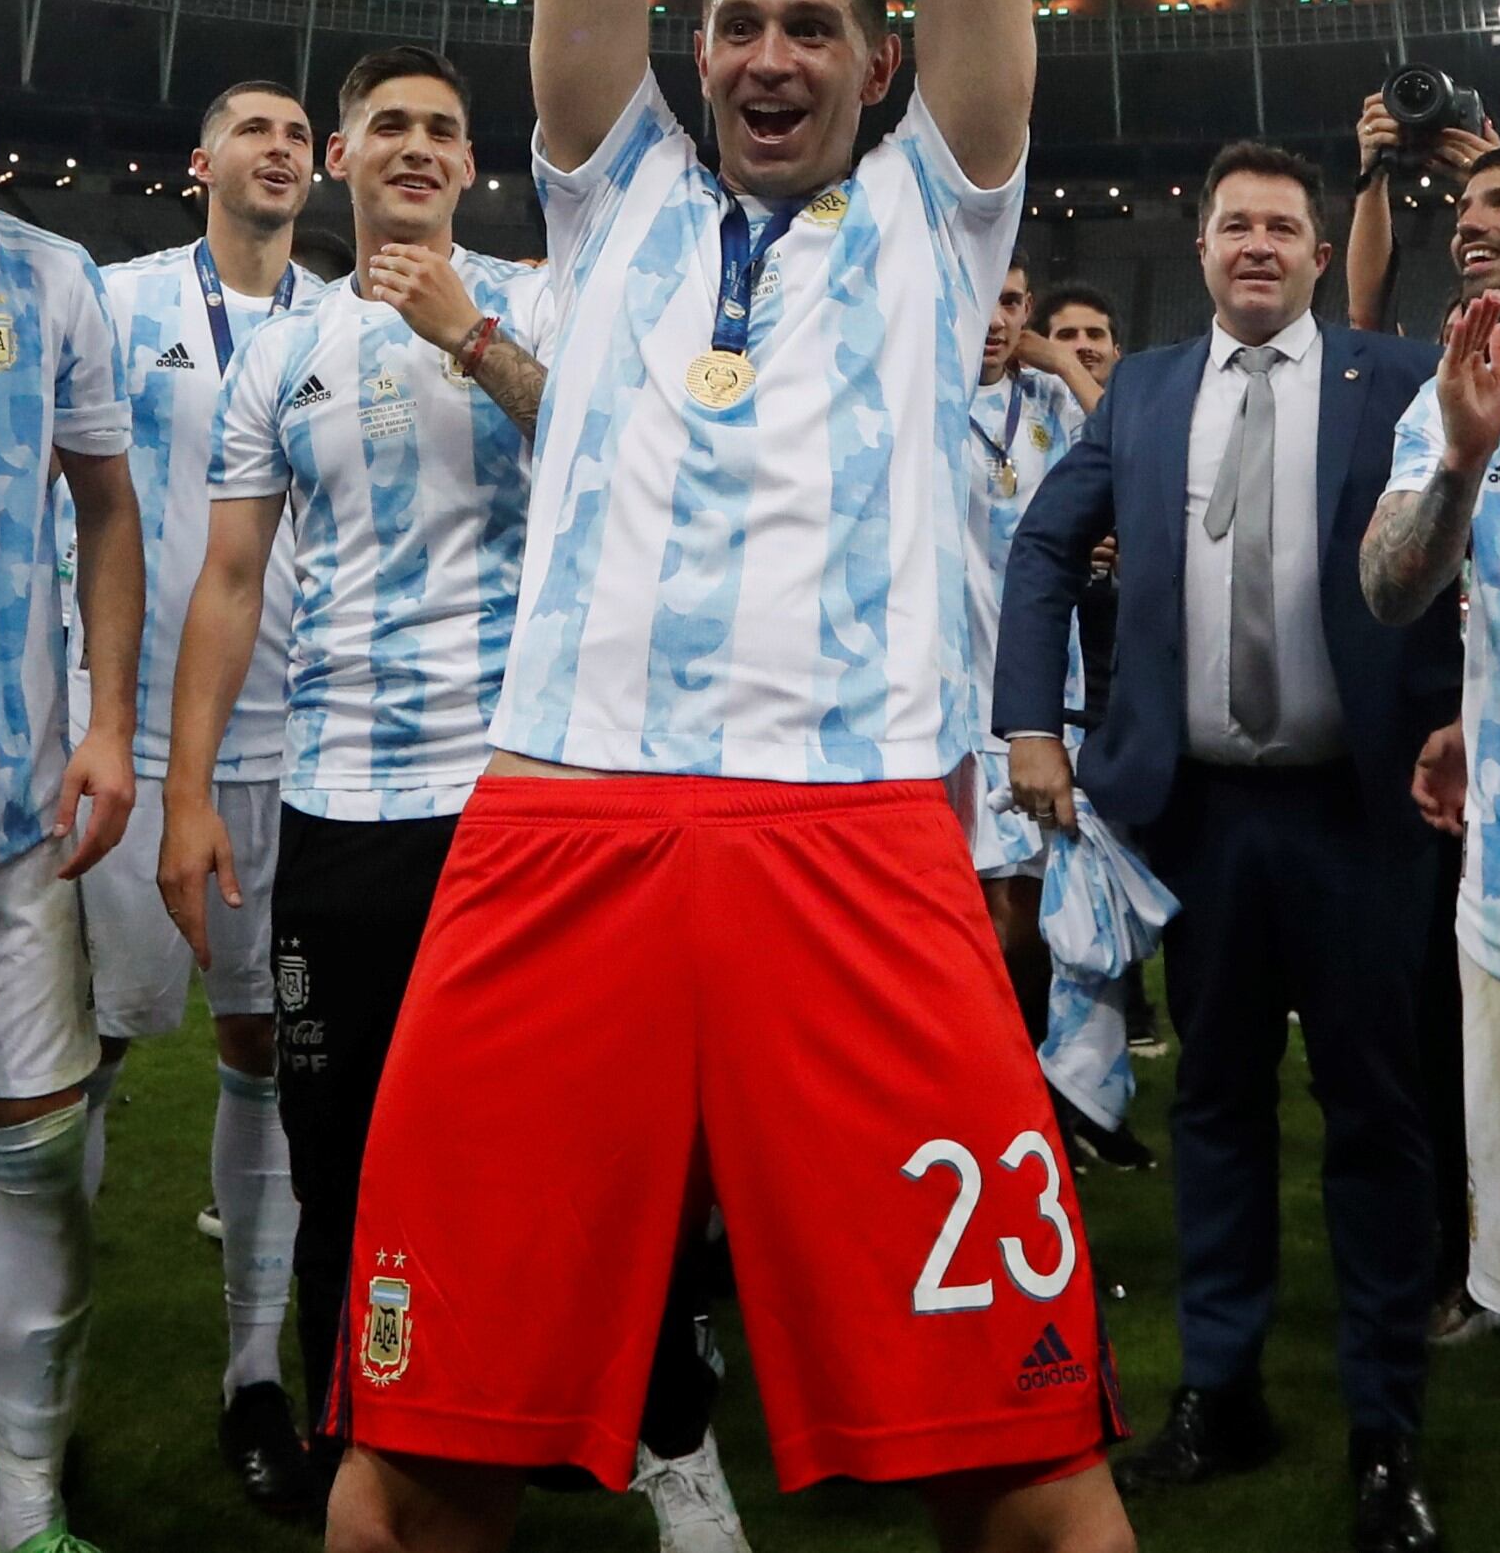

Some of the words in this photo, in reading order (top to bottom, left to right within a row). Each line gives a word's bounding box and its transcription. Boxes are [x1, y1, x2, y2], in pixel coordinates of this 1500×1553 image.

[811, 188, 846, 213] AFA
[156, 357, 195, 369] adidas
[378, 379, 393, 390] 15
[293, 390, 332, 409] adidas
[899, 1130, 1076, 1315] 23
[372, 1306, 399, 1353] AFA
[1016, 1363, 1088, 1391] adidas
